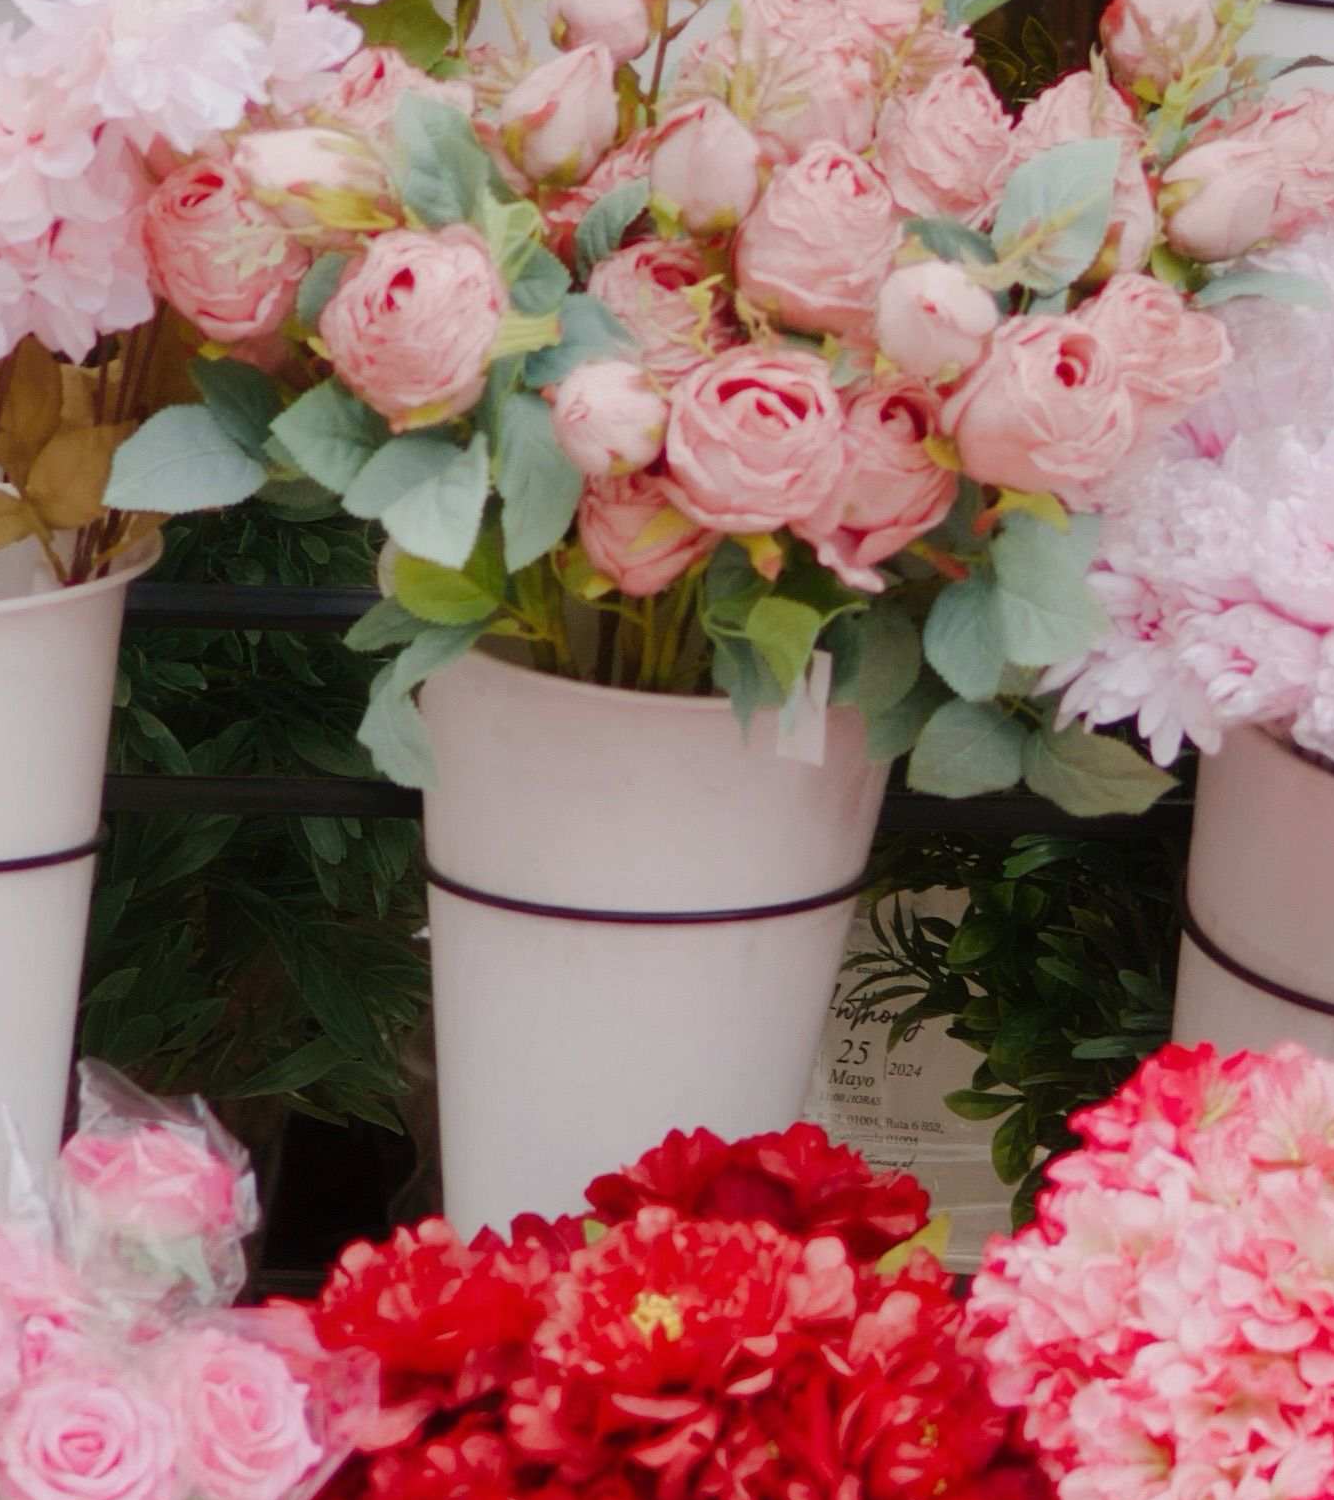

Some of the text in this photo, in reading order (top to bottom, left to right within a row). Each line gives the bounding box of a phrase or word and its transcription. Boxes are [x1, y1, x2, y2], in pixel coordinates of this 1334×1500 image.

[836, 1039, 871, 1065] 25
[828, 1068, 875, 1090] Mayo
[888, 1062, 923, 1078] 2024
